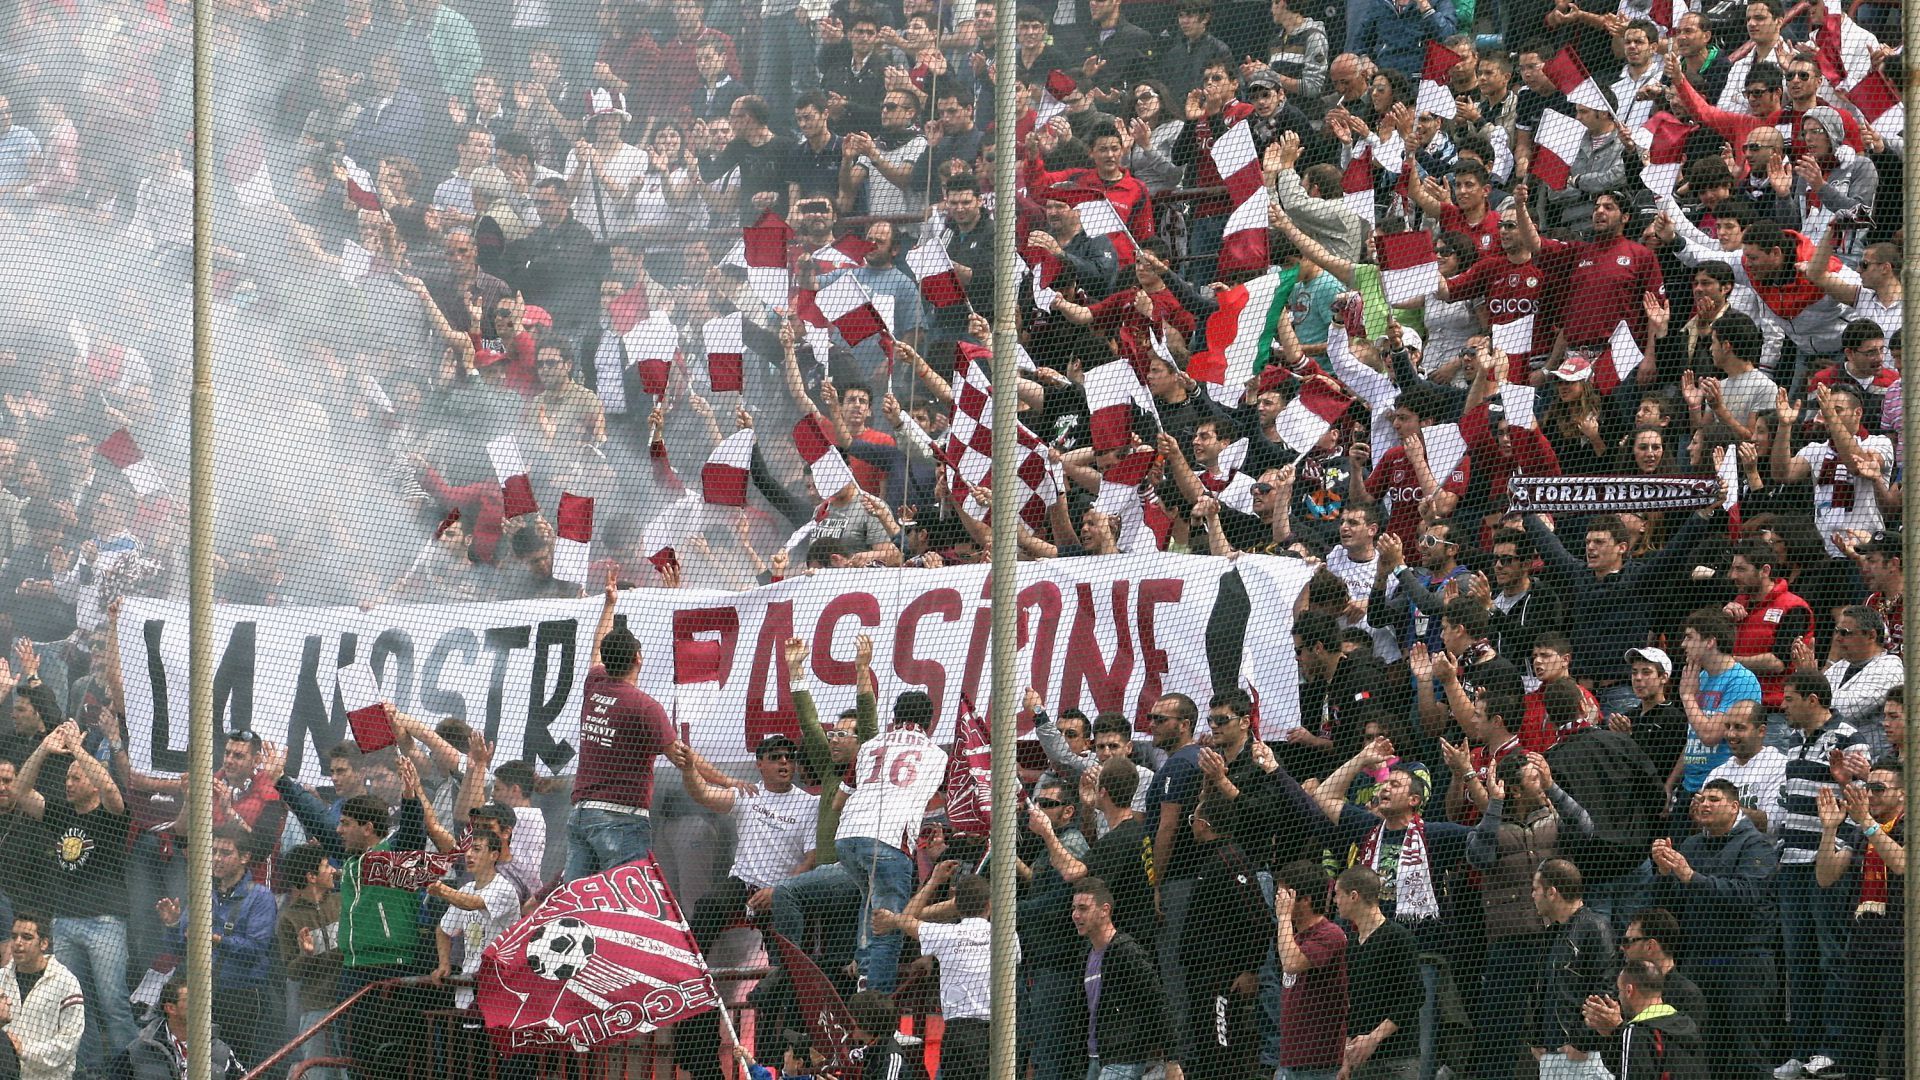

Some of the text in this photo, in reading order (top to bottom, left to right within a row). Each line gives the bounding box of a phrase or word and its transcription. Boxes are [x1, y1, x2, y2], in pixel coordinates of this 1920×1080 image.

[1489, 298, 1539, 314] GICOS
[1389, 487, 1422, 501] GICO
[1535, 483, 1692, 502] FORZA REGGINA
[144, 619, 256, 775] LA
[285, 615, 627, 778] NOSTR
[863, 746, 922, 788] 16
[778, 815, 796, 825] SUD
